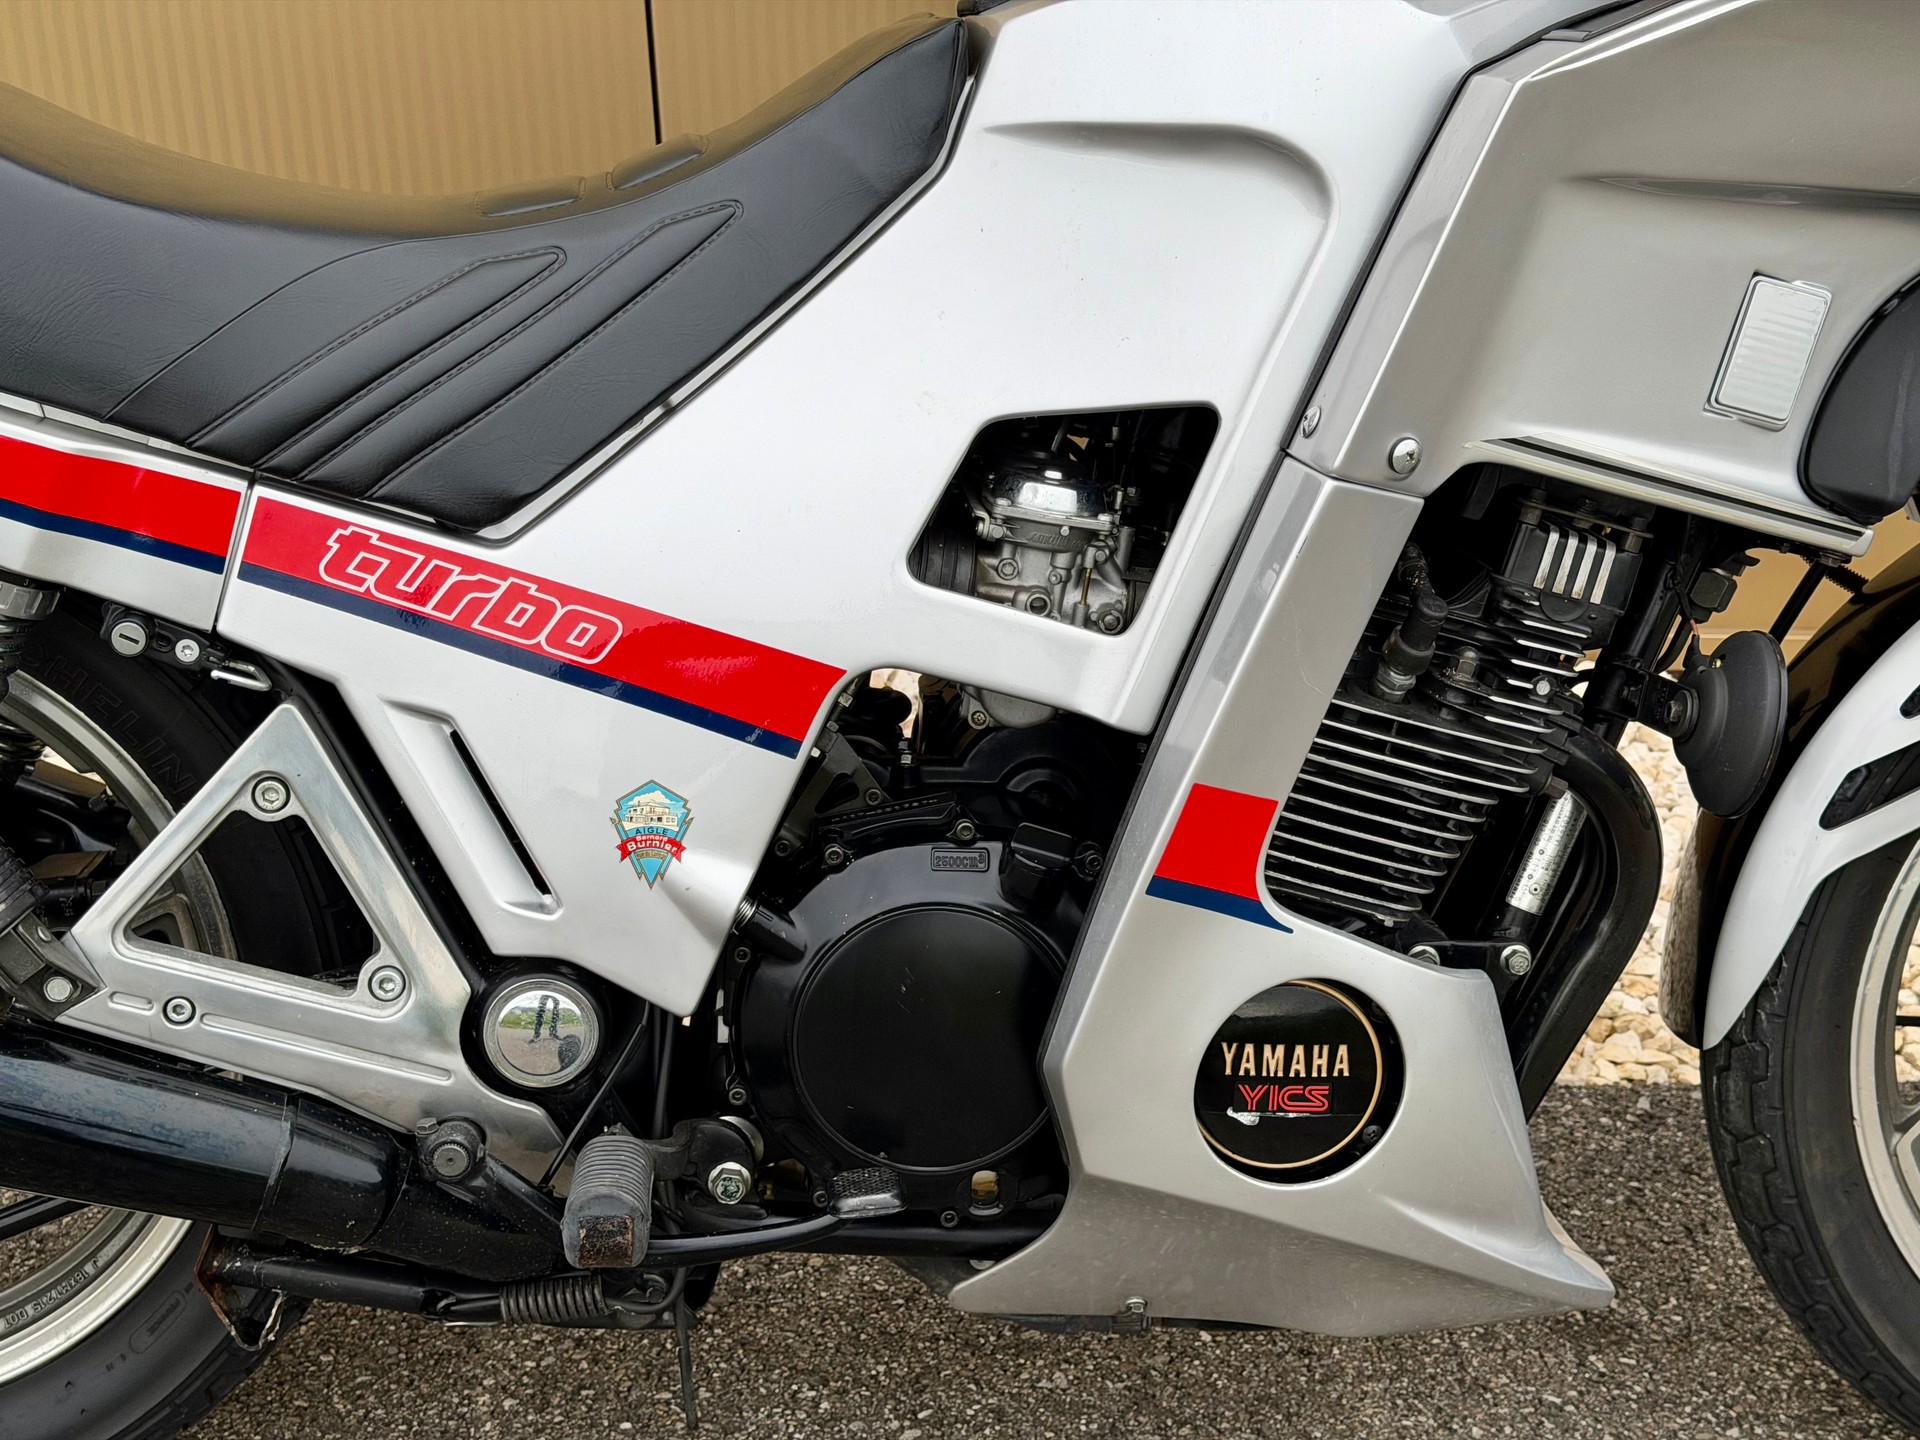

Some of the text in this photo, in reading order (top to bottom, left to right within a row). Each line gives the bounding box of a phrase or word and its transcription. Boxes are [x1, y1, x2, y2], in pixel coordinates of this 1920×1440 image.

[319, 525, 623, 664] turbo
[635, 826, 669, 836] AIGLE
[635, 834, 669, 842] Bernard
[626, 840, 678, 853] Burnier
[1221, 1041, 1350, 1078] YAMAHA
[1238, 1084, 1330, 1113] YICS
